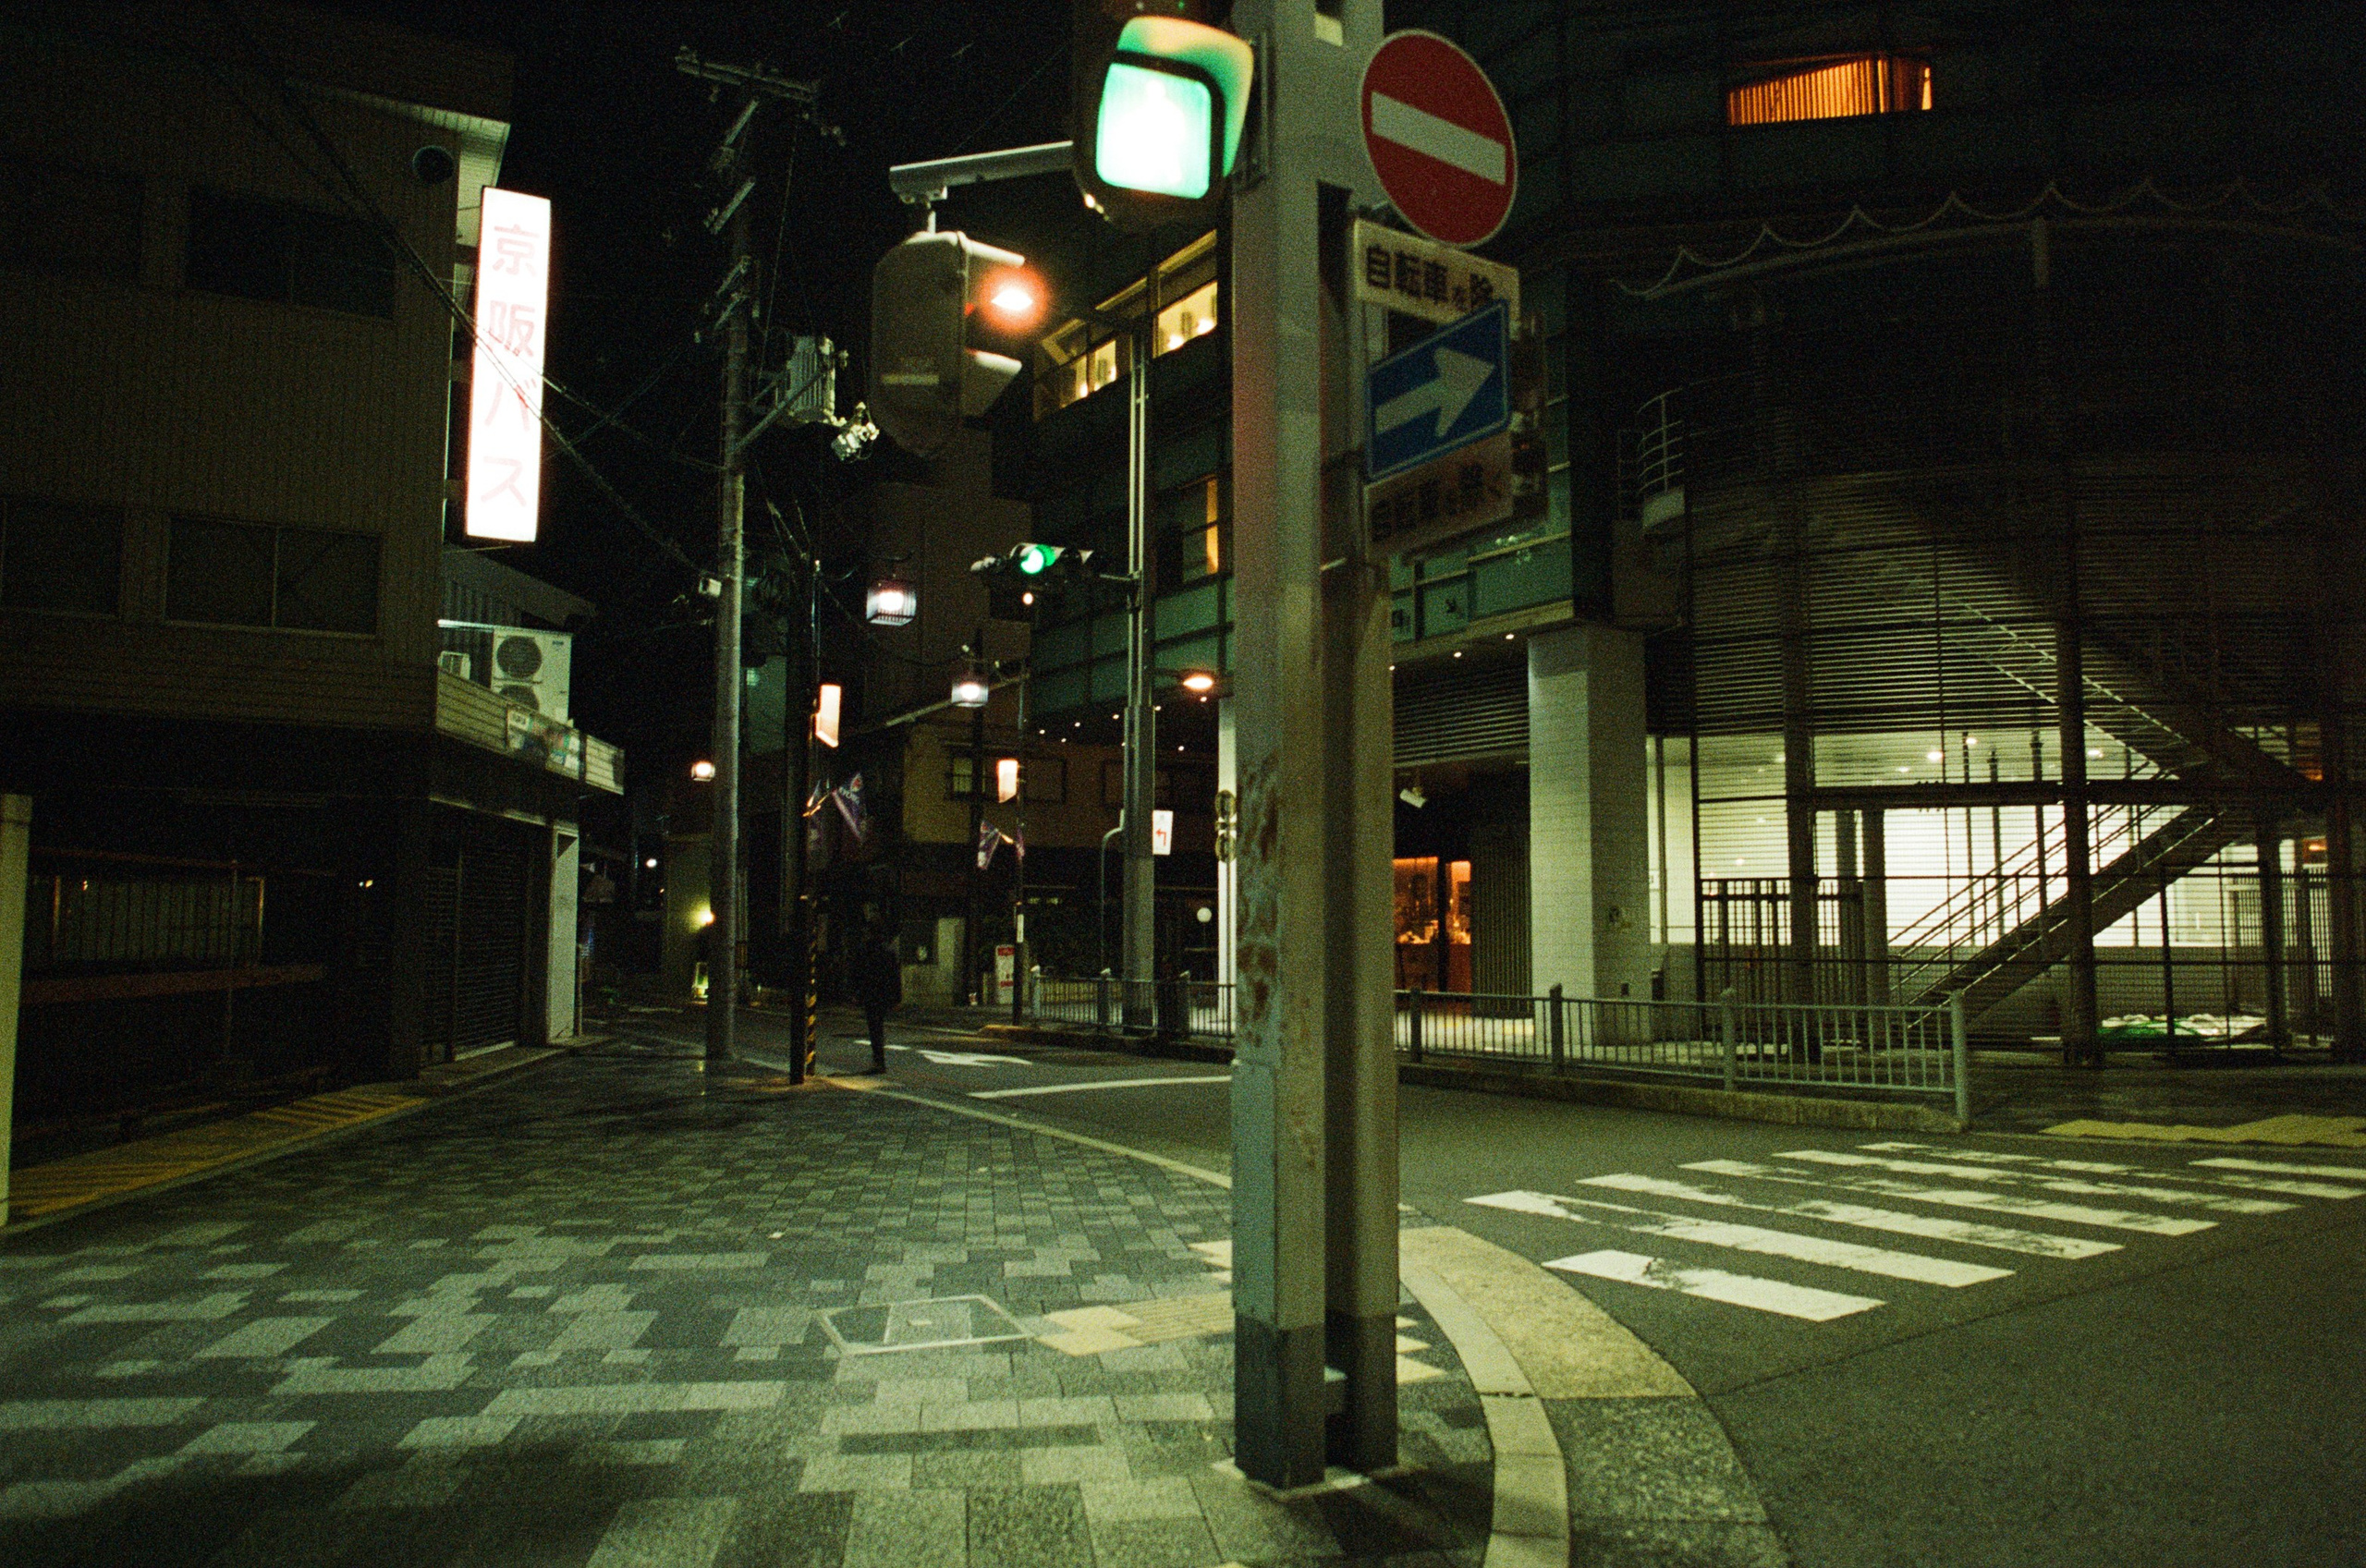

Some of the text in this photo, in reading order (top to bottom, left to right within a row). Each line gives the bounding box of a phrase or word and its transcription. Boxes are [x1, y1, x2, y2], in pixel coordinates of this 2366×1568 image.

[481, 224, 540, 507] 京阪バス
[1366, 244, 1494, 312] 自転車を除
